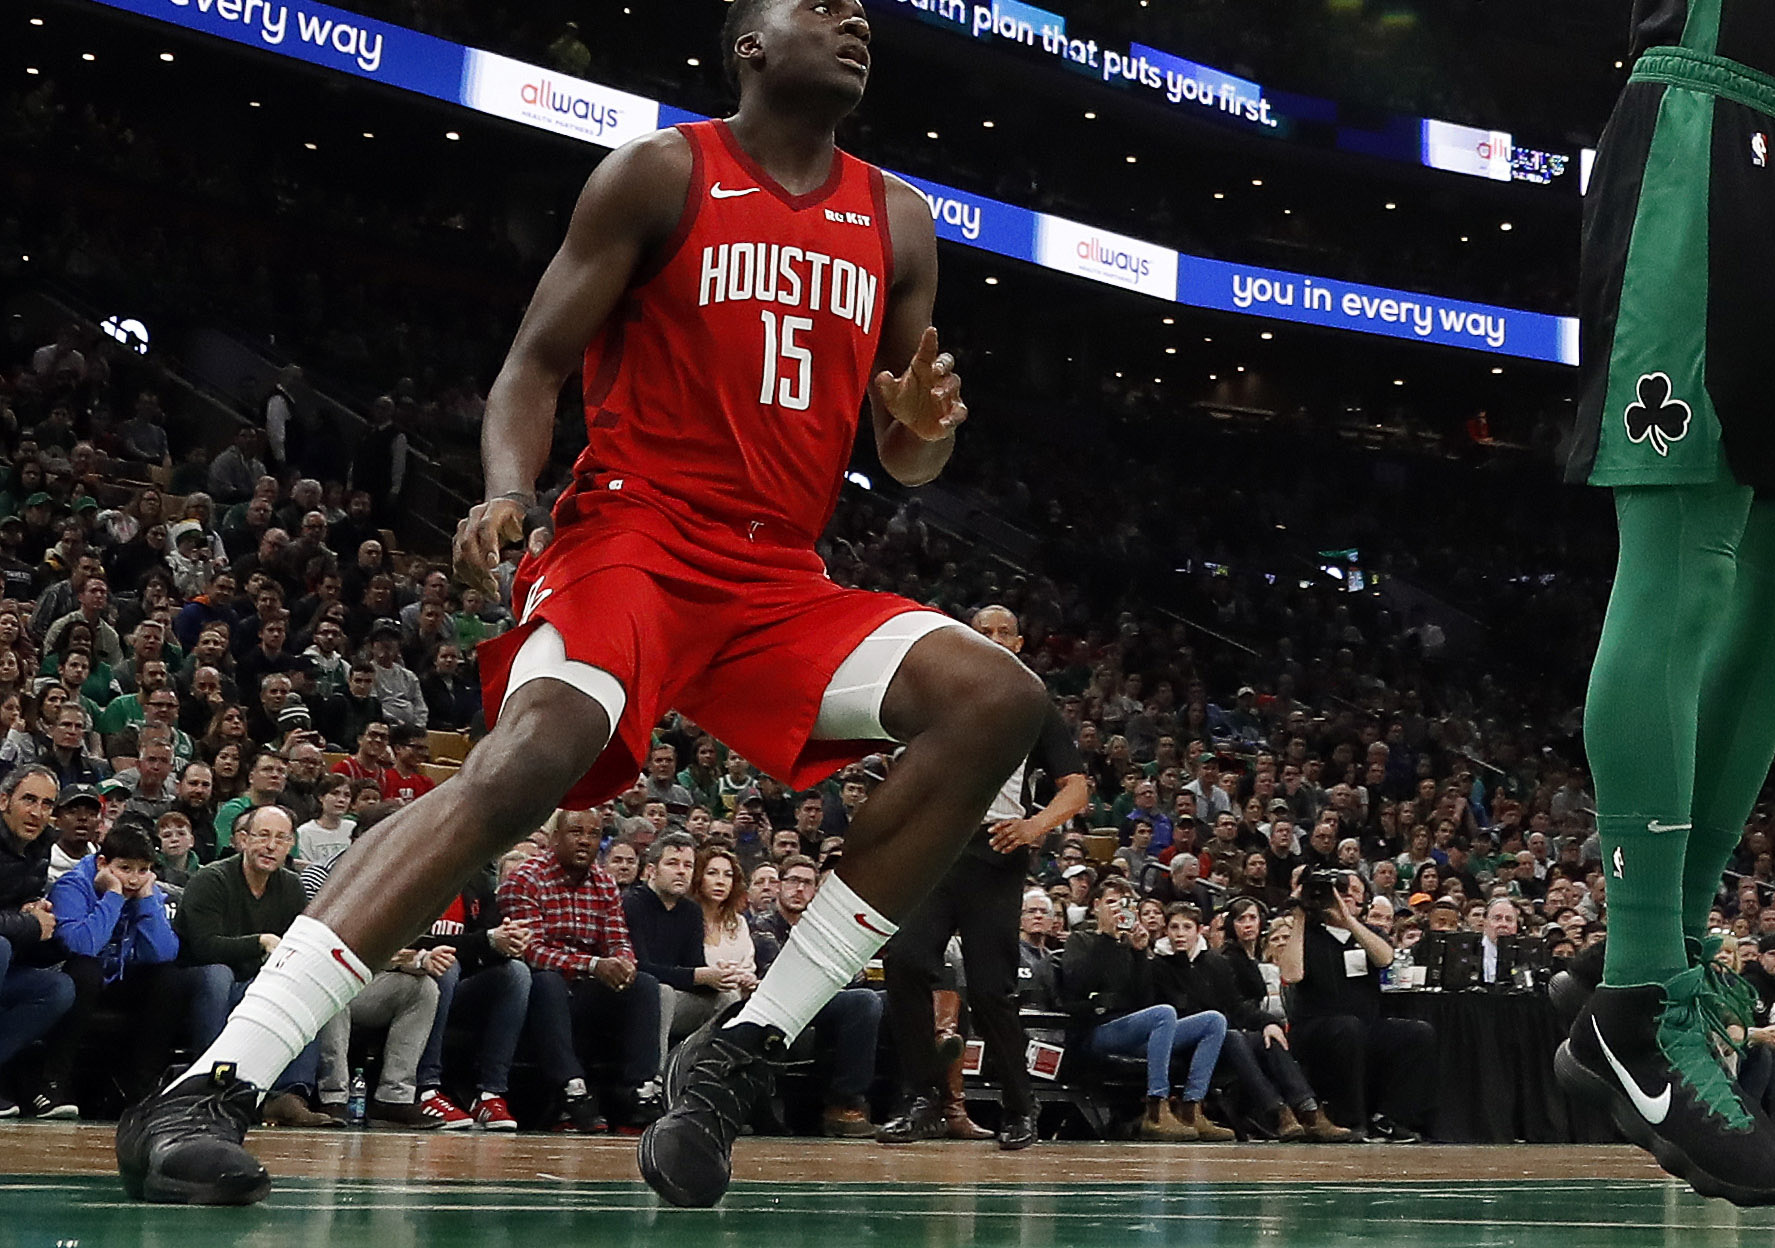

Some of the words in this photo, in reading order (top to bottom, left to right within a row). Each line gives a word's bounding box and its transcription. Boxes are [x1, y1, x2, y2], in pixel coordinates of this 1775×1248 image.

[297, 11, 383, 72] way
[972, 2, 1034, 46] plan
[1041, 24, 1099, 68] that
[1103, 50, 1162, 90] puts
[1166, 70, 1214, 103] you
[1218, 83, 1278, 127] first.
[520, 79, 619, 137] allways
[699, 242, 878, 335] HOUSTON
[1077, 237, 1150, 284] allways
[1232, 274, 1293, 308] you
[1303, 279, 1332, 312] in
[1341, 292, 1433, 336] every
[1438, 308, 1506, 347] way
[759, 309, 813, 412] 15
